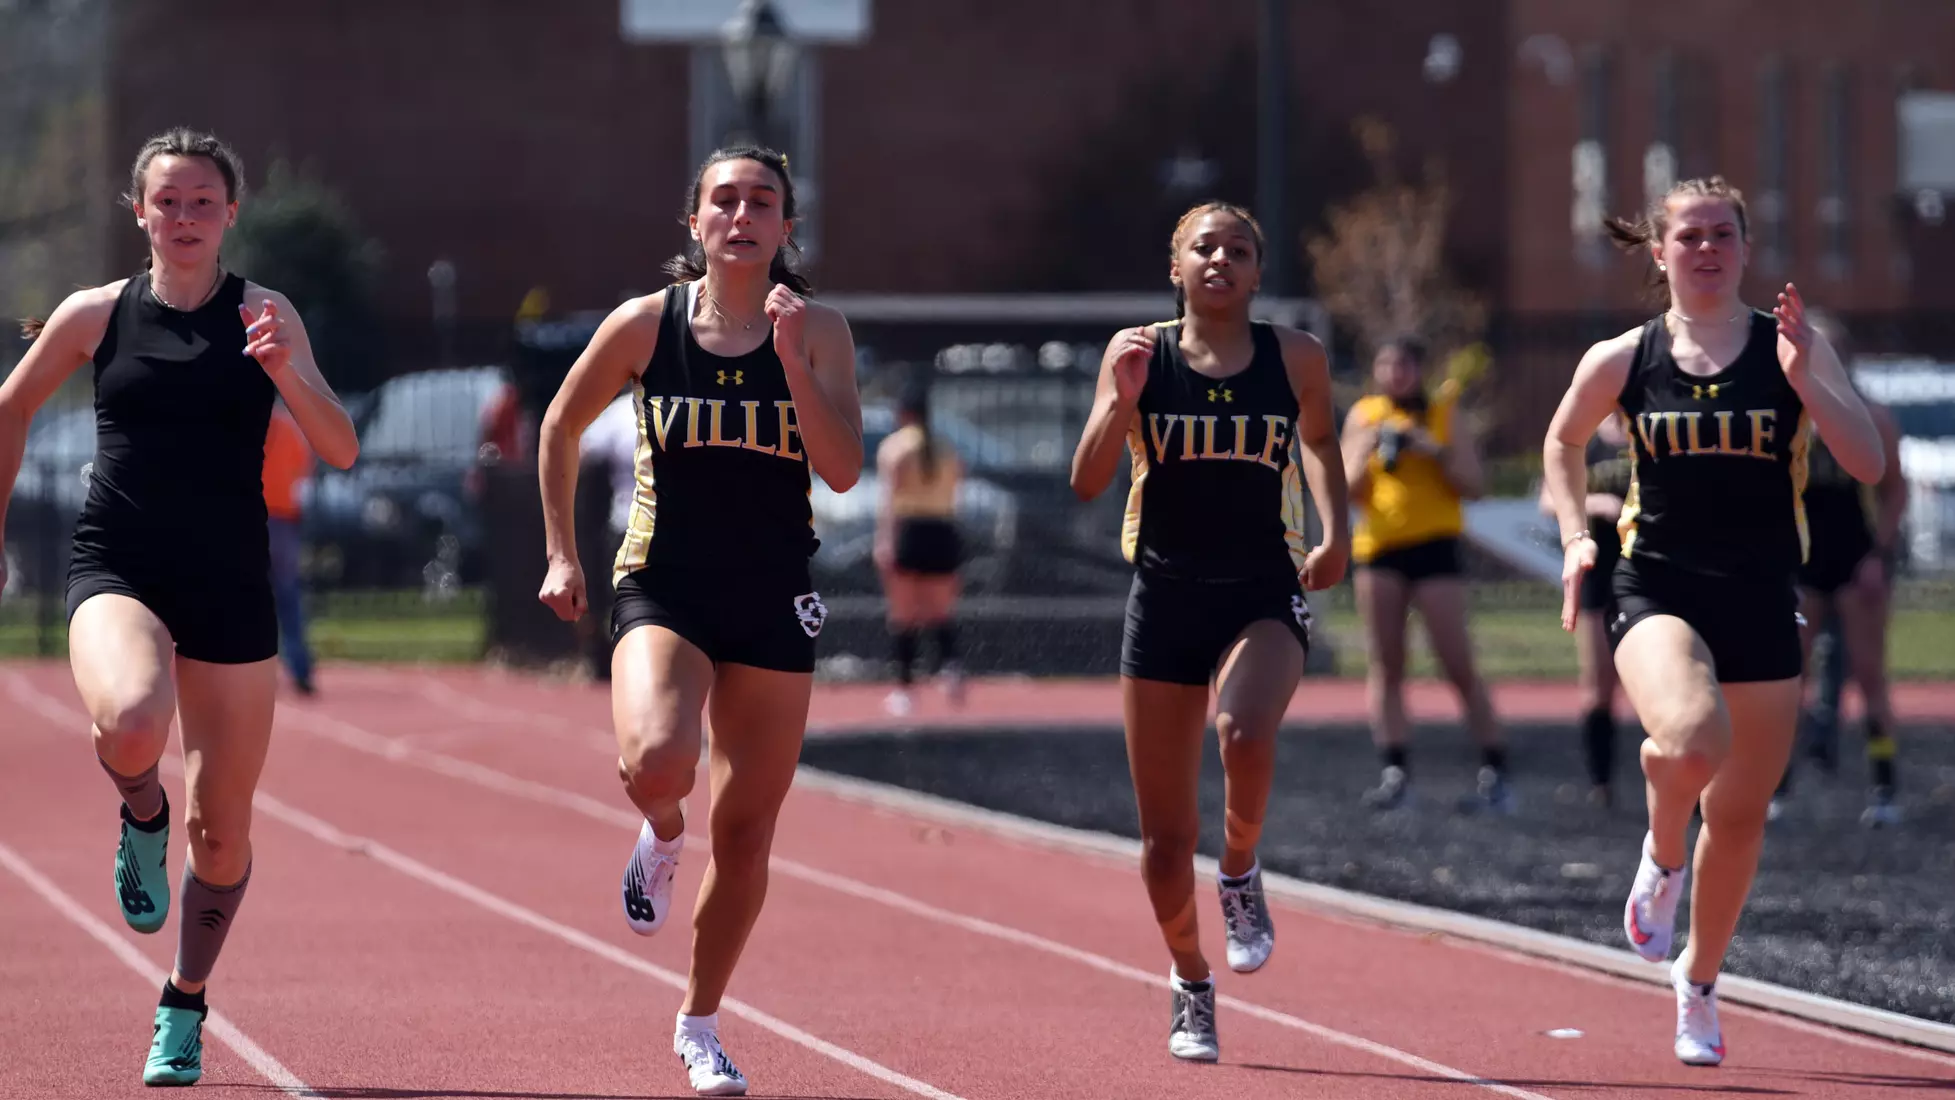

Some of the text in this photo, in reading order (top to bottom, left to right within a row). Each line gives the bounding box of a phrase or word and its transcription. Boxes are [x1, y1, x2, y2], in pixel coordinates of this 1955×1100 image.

[648, 396, 803, 461] VILLE
[1149, 413, 1288, 472] VILLE
[1636, 409, 1778, 464] VILLE
